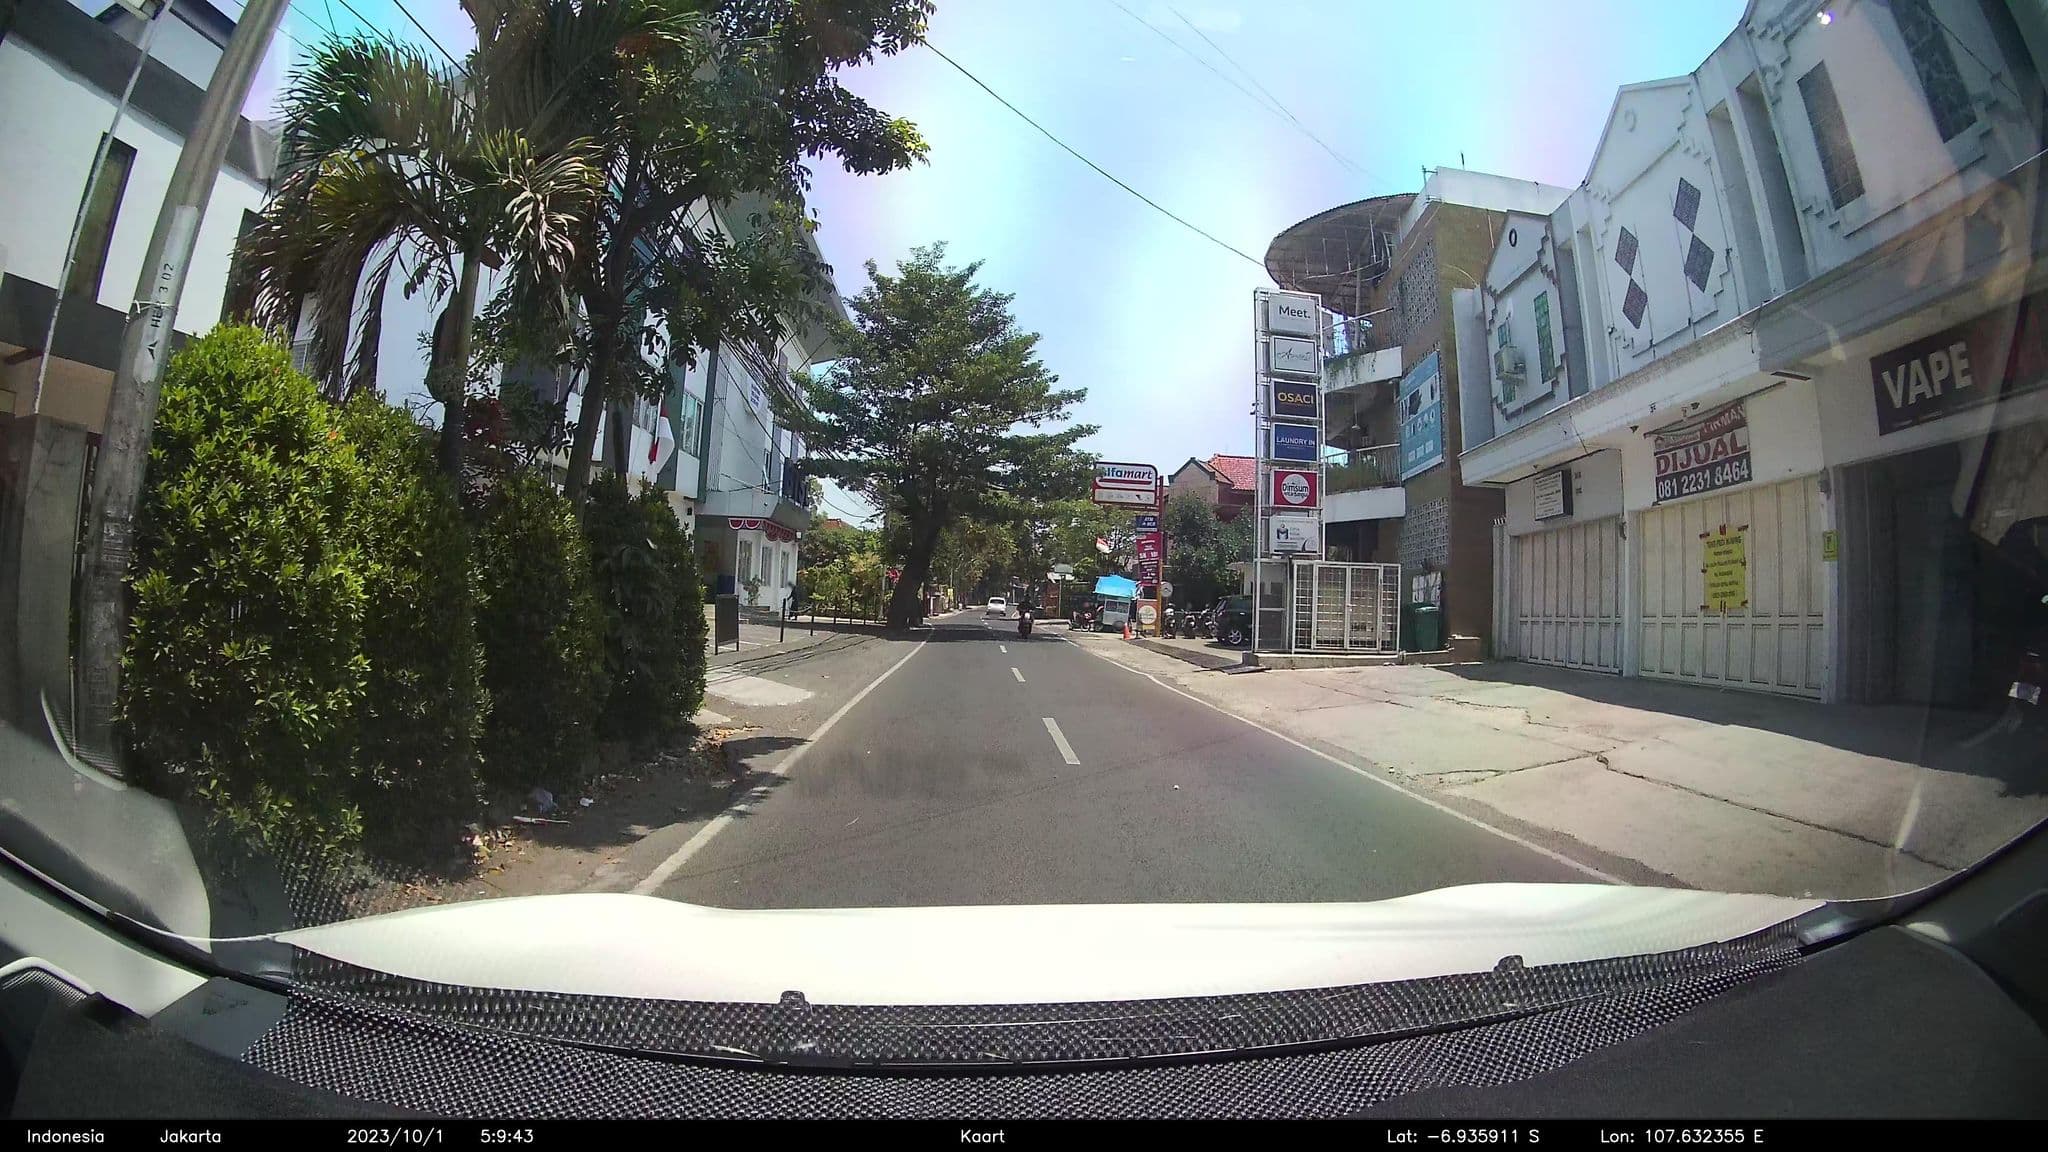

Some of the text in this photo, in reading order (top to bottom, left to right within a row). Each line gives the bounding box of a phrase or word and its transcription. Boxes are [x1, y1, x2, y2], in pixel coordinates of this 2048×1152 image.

[1278, 305, 1311, 319] Meet.
[1881, 341, 1973, 409] VAPE
[1276, 436, 1307, 446] LAUNDRY
[1656, 432, 1748, 475] DIJUAL
[1282, 482, 1309, 493] Dimsum
[1658, 458, 1749, 499] 081 2231 8464
